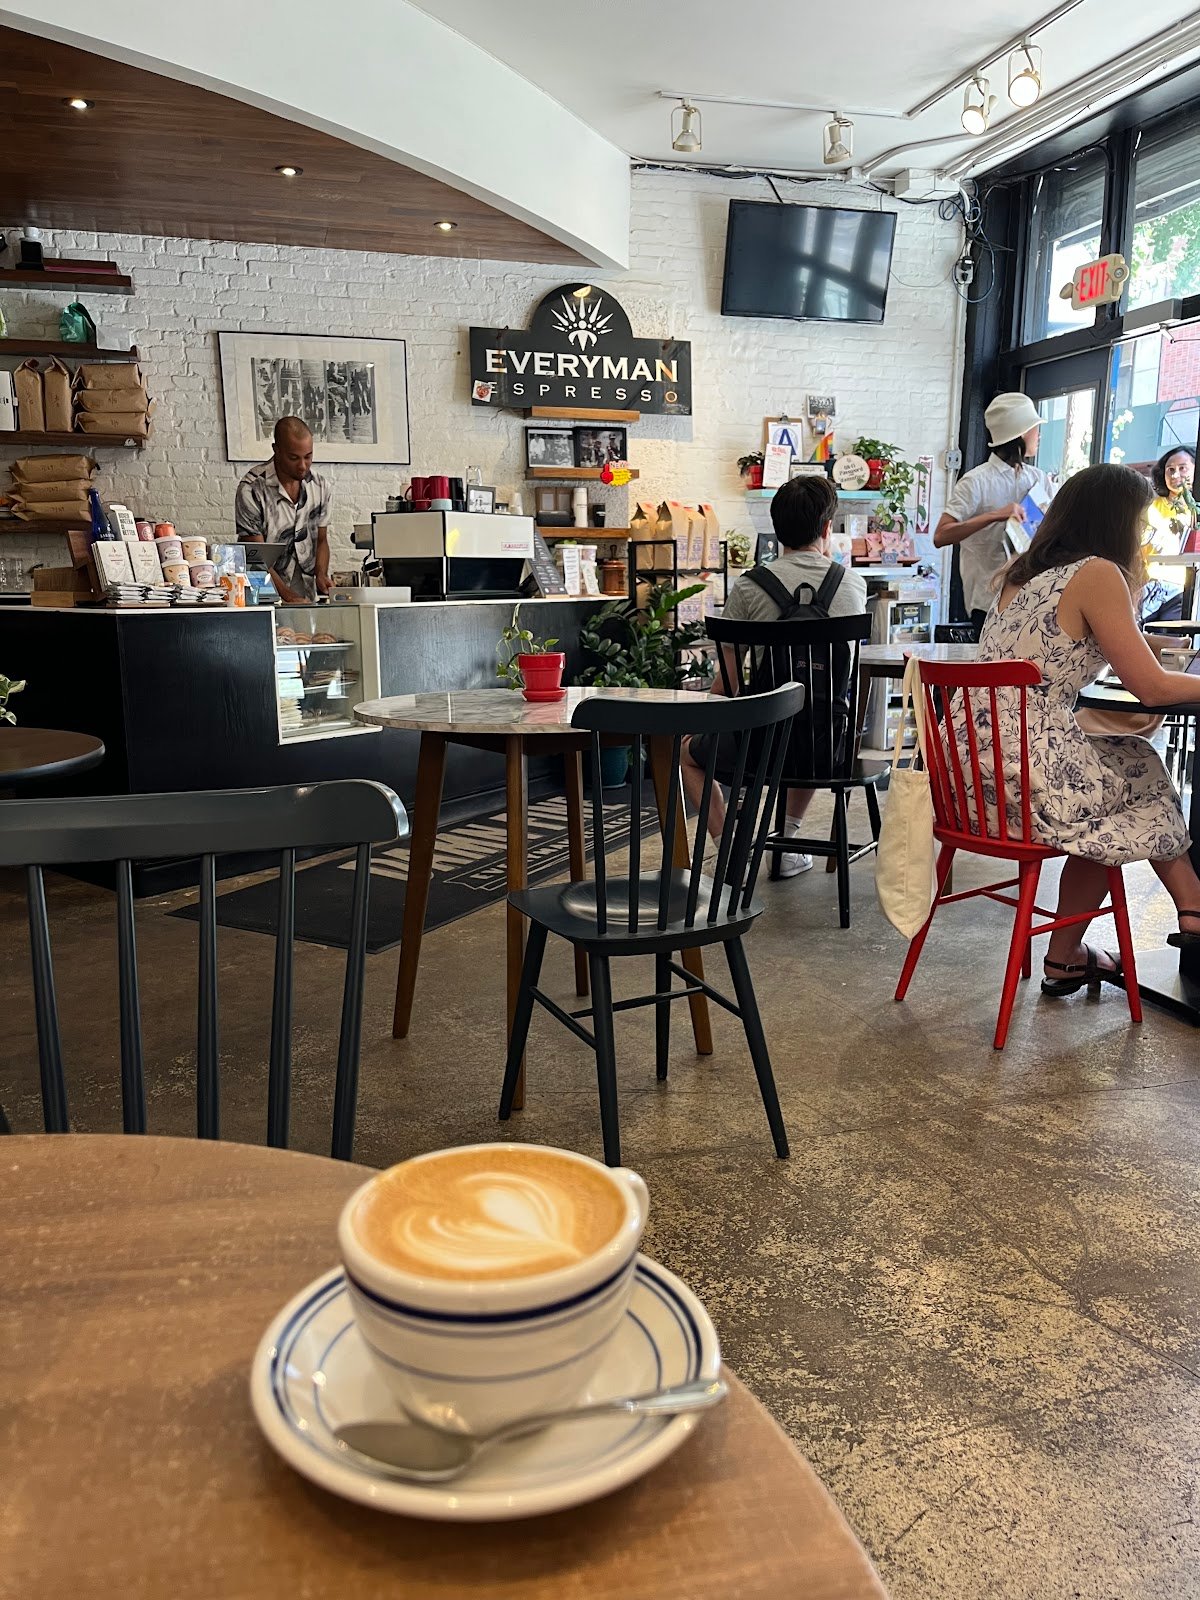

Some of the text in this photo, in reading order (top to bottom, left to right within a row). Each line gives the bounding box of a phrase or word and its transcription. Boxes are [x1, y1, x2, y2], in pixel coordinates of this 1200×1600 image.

[1079, 261, 1109, 302] EXIT
[485, 349, 678, 382] EVERYMAN
[779, 428, 797, 456] A
